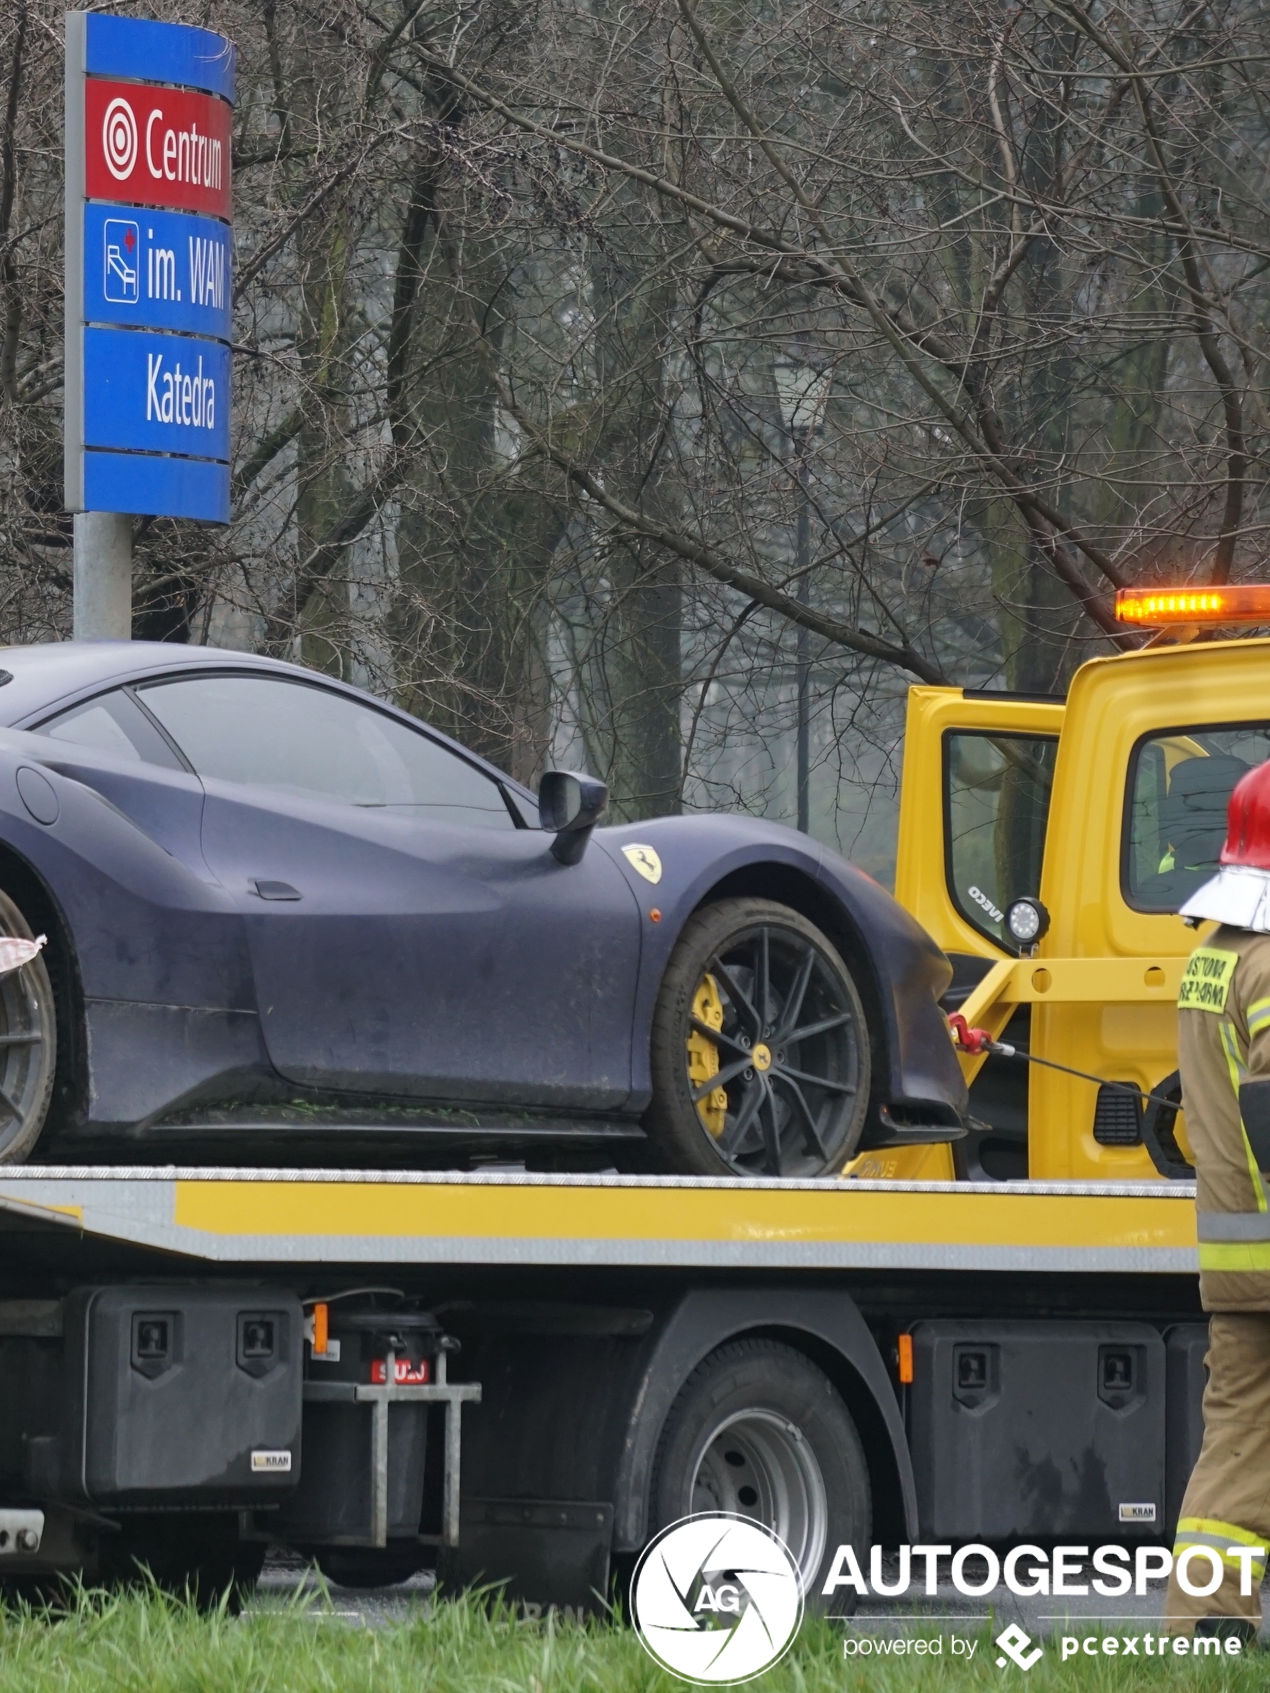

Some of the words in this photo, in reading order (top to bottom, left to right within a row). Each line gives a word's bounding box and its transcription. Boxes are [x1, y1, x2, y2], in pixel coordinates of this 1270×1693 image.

[146, 109, 222, 191] Centrum
[147, 228, 182, 302] im.
[189, 235, 224, 310] WAM
[146, 353, 215, 430] Katedra
